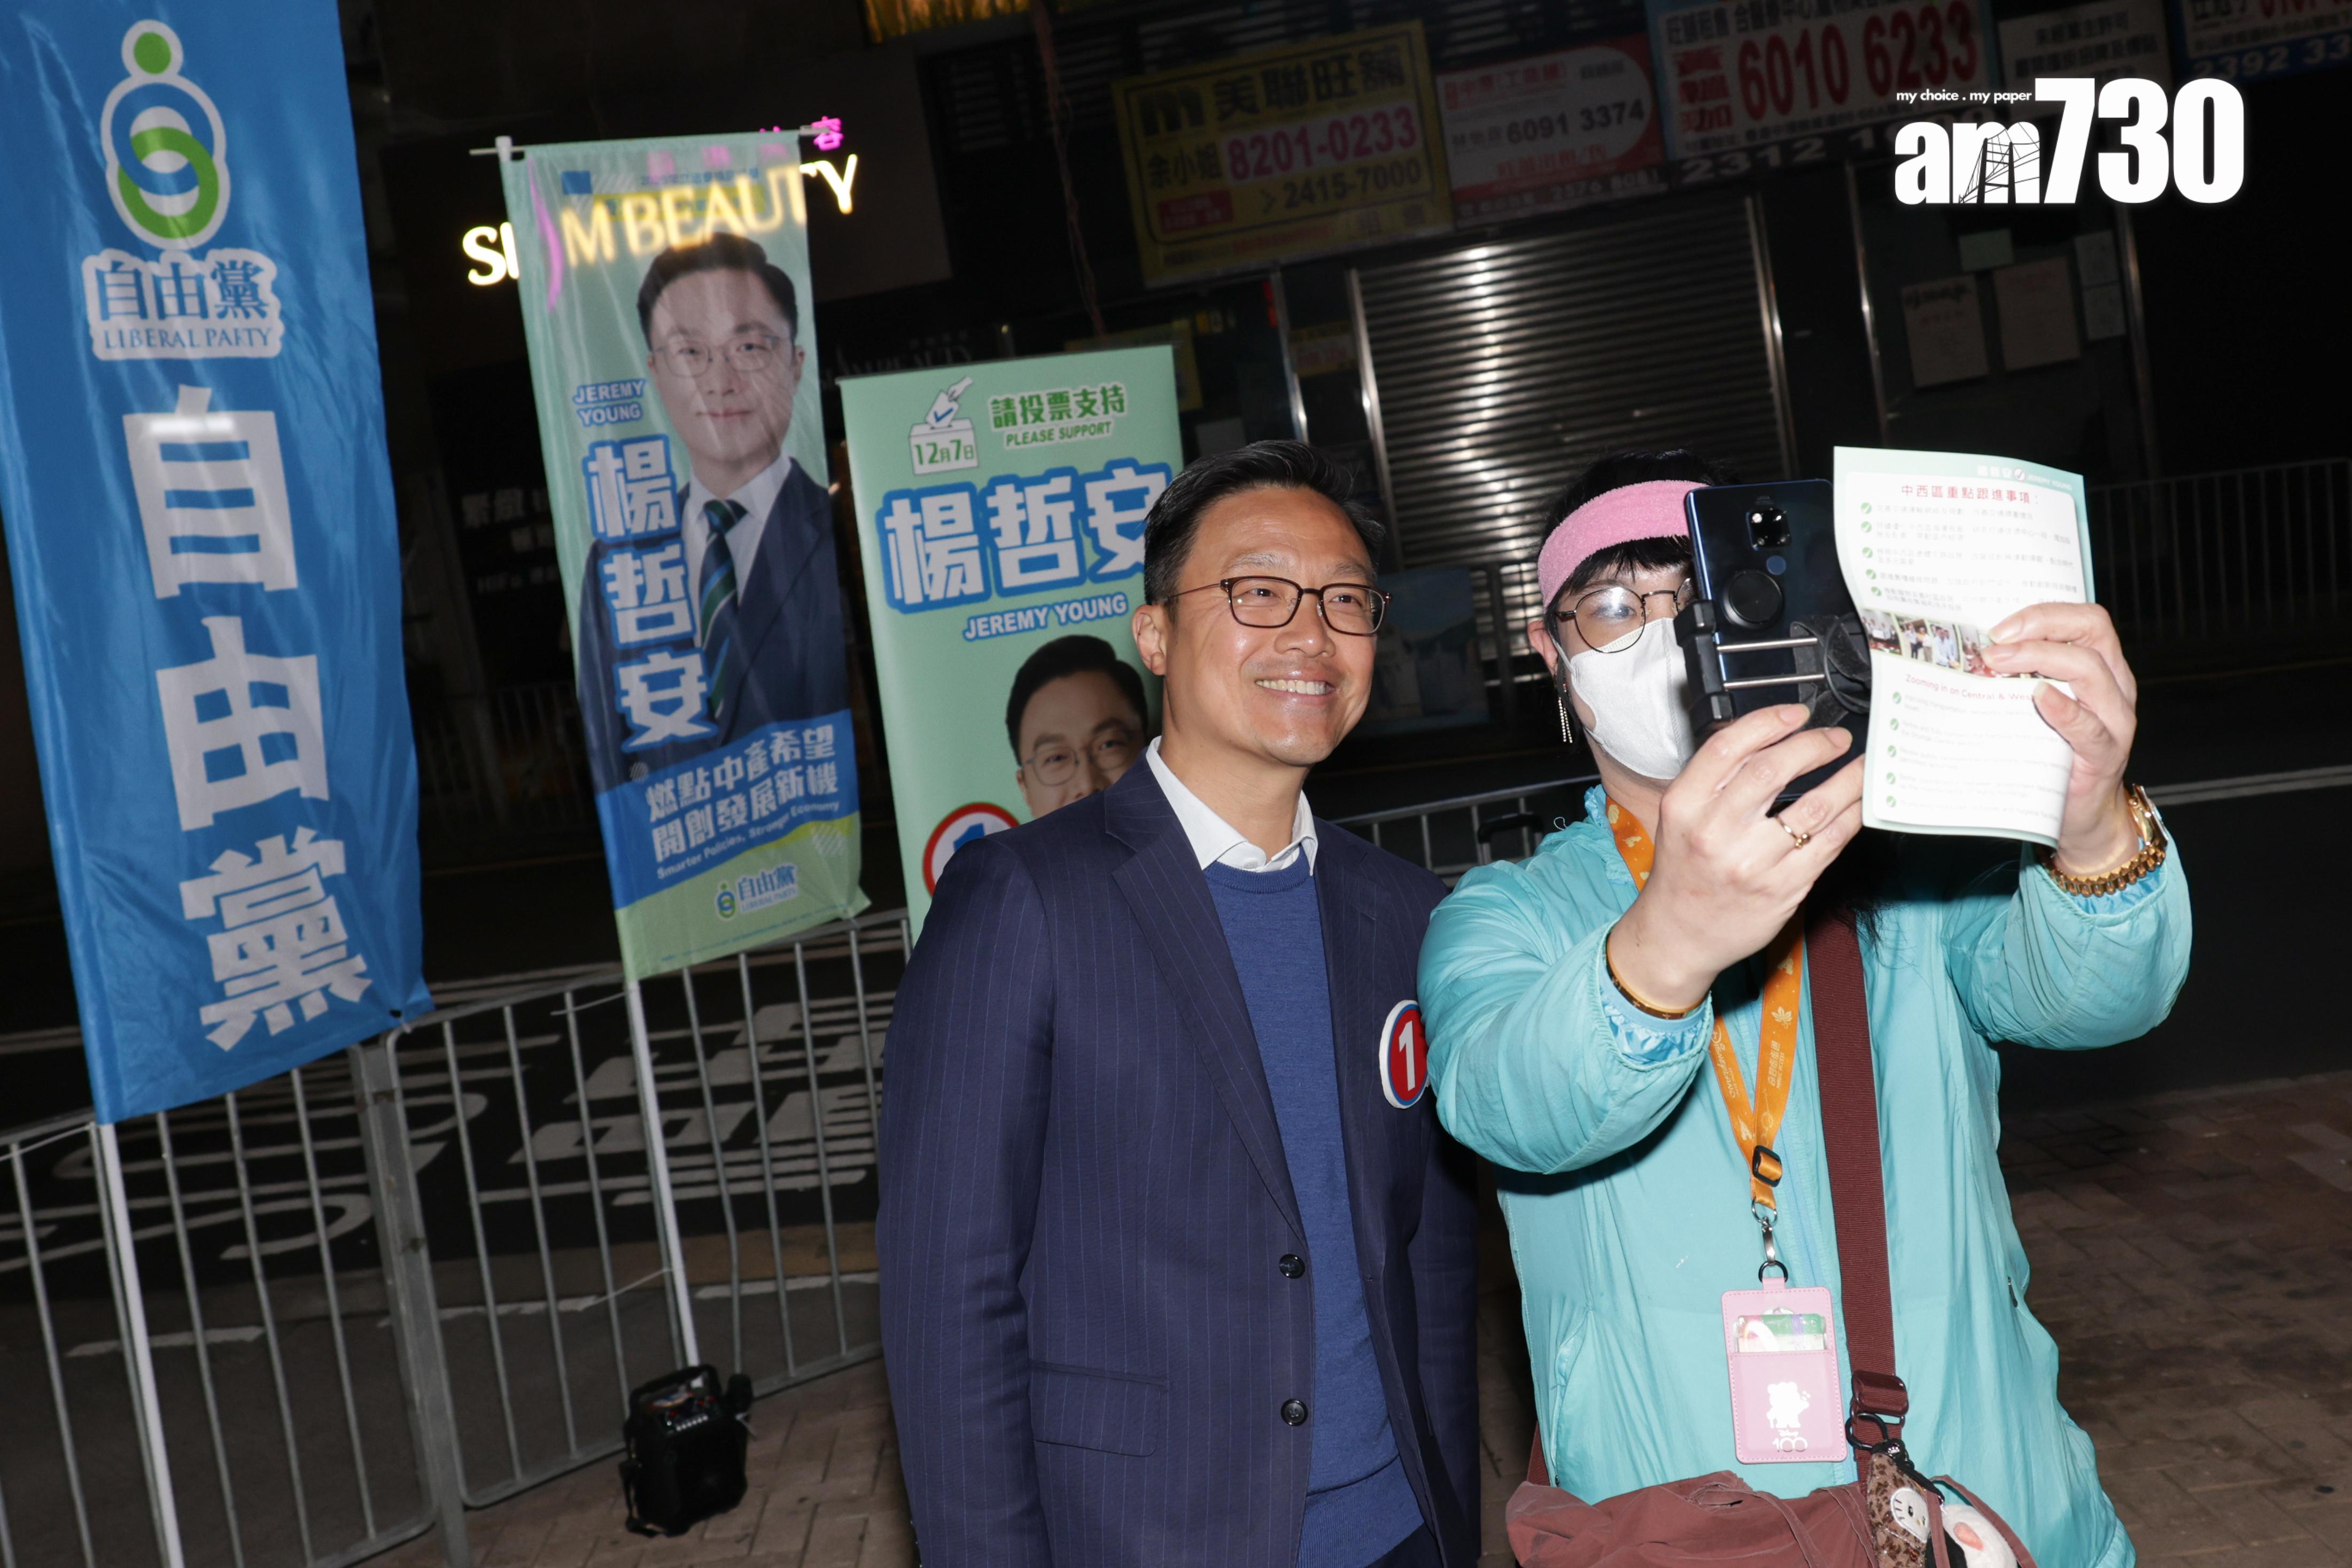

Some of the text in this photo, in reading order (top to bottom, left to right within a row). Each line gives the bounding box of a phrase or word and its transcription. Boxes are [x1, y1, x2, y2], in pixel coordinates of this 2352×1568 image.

[1212, 43, 1406, 122] 美聯旺舖
[1738, 24, 1850, 121] 6010
[1864, 0, 1977, 97] 6233
[1228, 106, 1417, 181] 8201-0233
[1507, 111, 1569, 145] 6091
[1580, 98, 1644, 131] 3374
[1285, 156, 1422, 209] 2415-7000
[1681, 137, 1826, 184] 2312
[622, 153, 858, 258] BEAUTY
[95, 260, 269, 321] 自由黨
[104, 327, 273, 349] LIBERAL PARTY
[575, 379, 644, 403] JEREMY
[579, 403, 642, 426] YOUNG
[991, 384, 1125, 429] 請投票支持
[914, 439, 975, 465] 12月7日
[1005, 421, 1113, 448] PLEASE SUPPORT
[884, 466, 1169, 606] 楊哲安
[587, 438, 716, 748] 楊哲安
[965, 594, 1128, 640] JEREMY YOUNG
[1906, 674, 1939, 692] Zooming
[1940, 681, 1948, 693] in
[1950, 687, 1960, 696] on
[1961, 688, 1995, 701] Central
[2009, 693, 2032, 701] Wes
[122, 384, 372, 1052] 自由黨
[645, 724, 836, 823] 燃點中產希望
[651, 762, 839, 863] 開創發展新機
[656, 801, 840, 880] Smarter Policies, Stronger Economy
[1398, 1020, 1416, 1091] 1
[1772, 1437, 1808, 1453] 100
